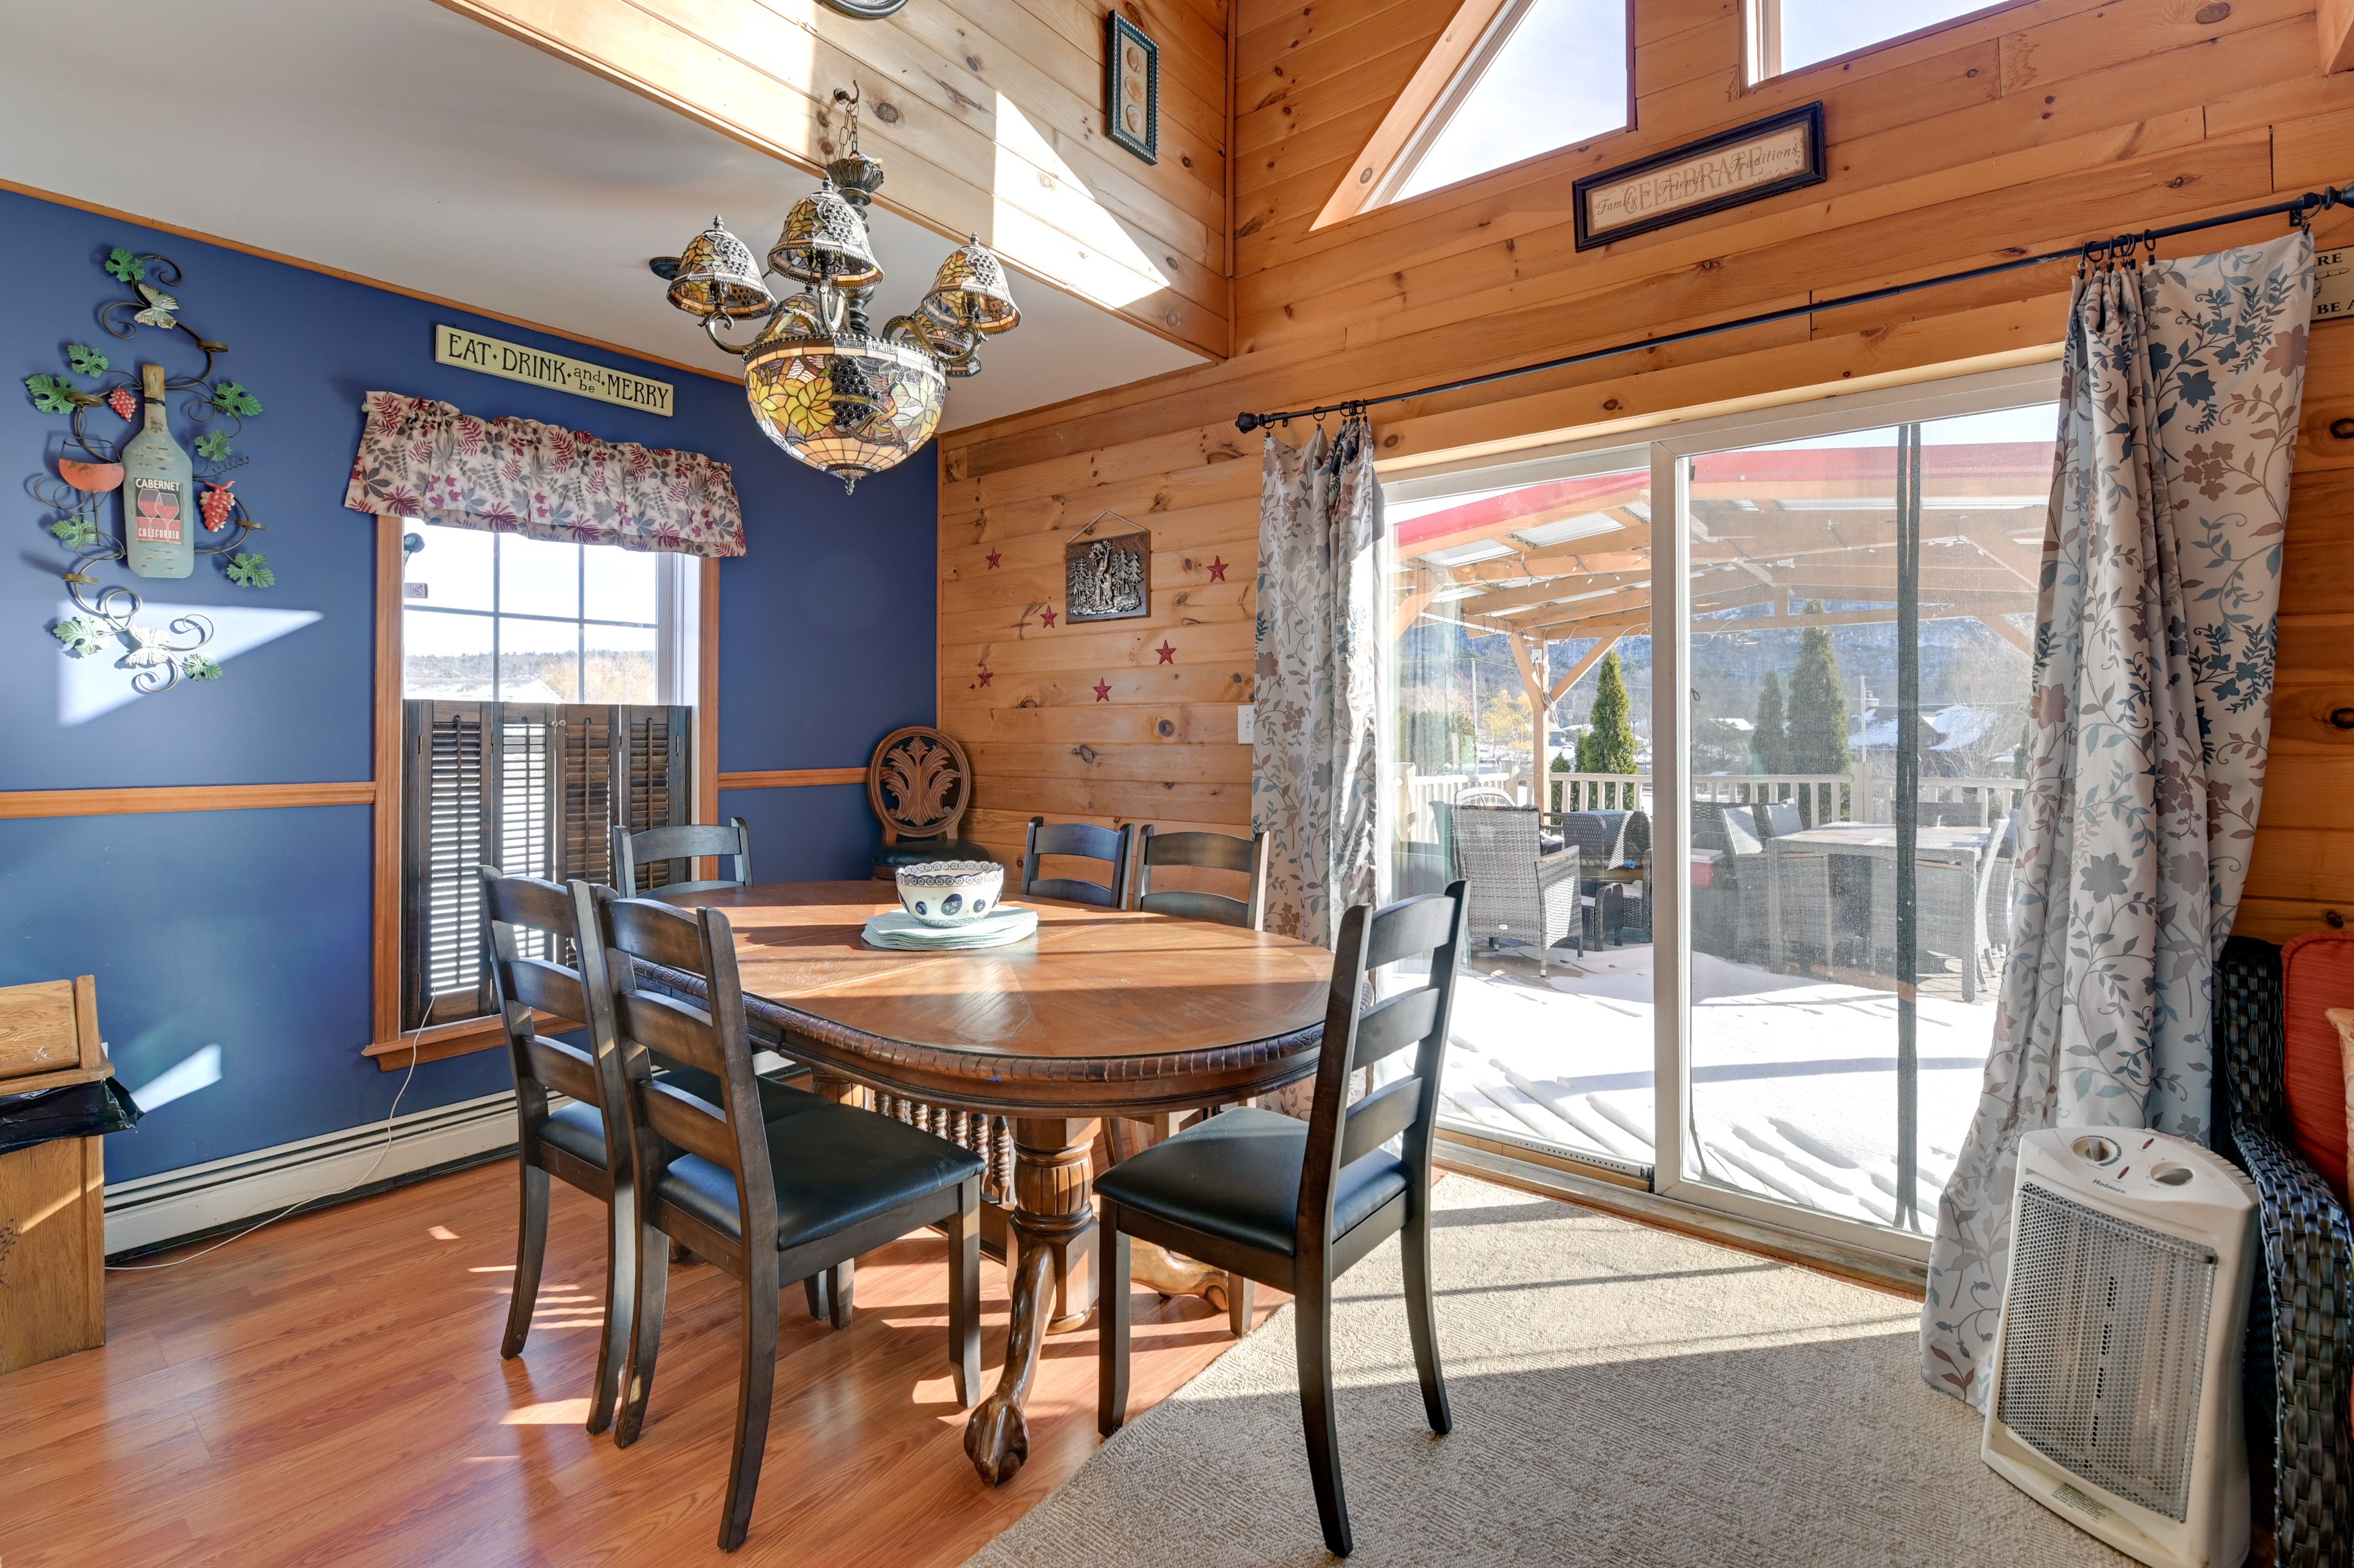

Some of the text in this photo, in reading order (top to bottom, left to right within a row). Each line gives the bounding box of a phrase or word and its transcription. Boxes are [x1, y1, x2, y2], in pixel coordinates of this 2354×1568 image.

[1624, 146, 1764, 215] CELEBRATE
[1597, 191, 1637, 216] Family
[1658, 171, 1706, 197] Friends
[2314, 253, 2342, 267] RE
[2317, 302, 2341, 314] BE
[448, 333, 669, 409] EAT DRINK and MERRY
[579, 379, 595, 394] be
[135, 478, 180, 492] CABERNET
[138, 528, 180, 540] CALIFORNIA
[2092, 1179, 2127, 1194] Holmes
